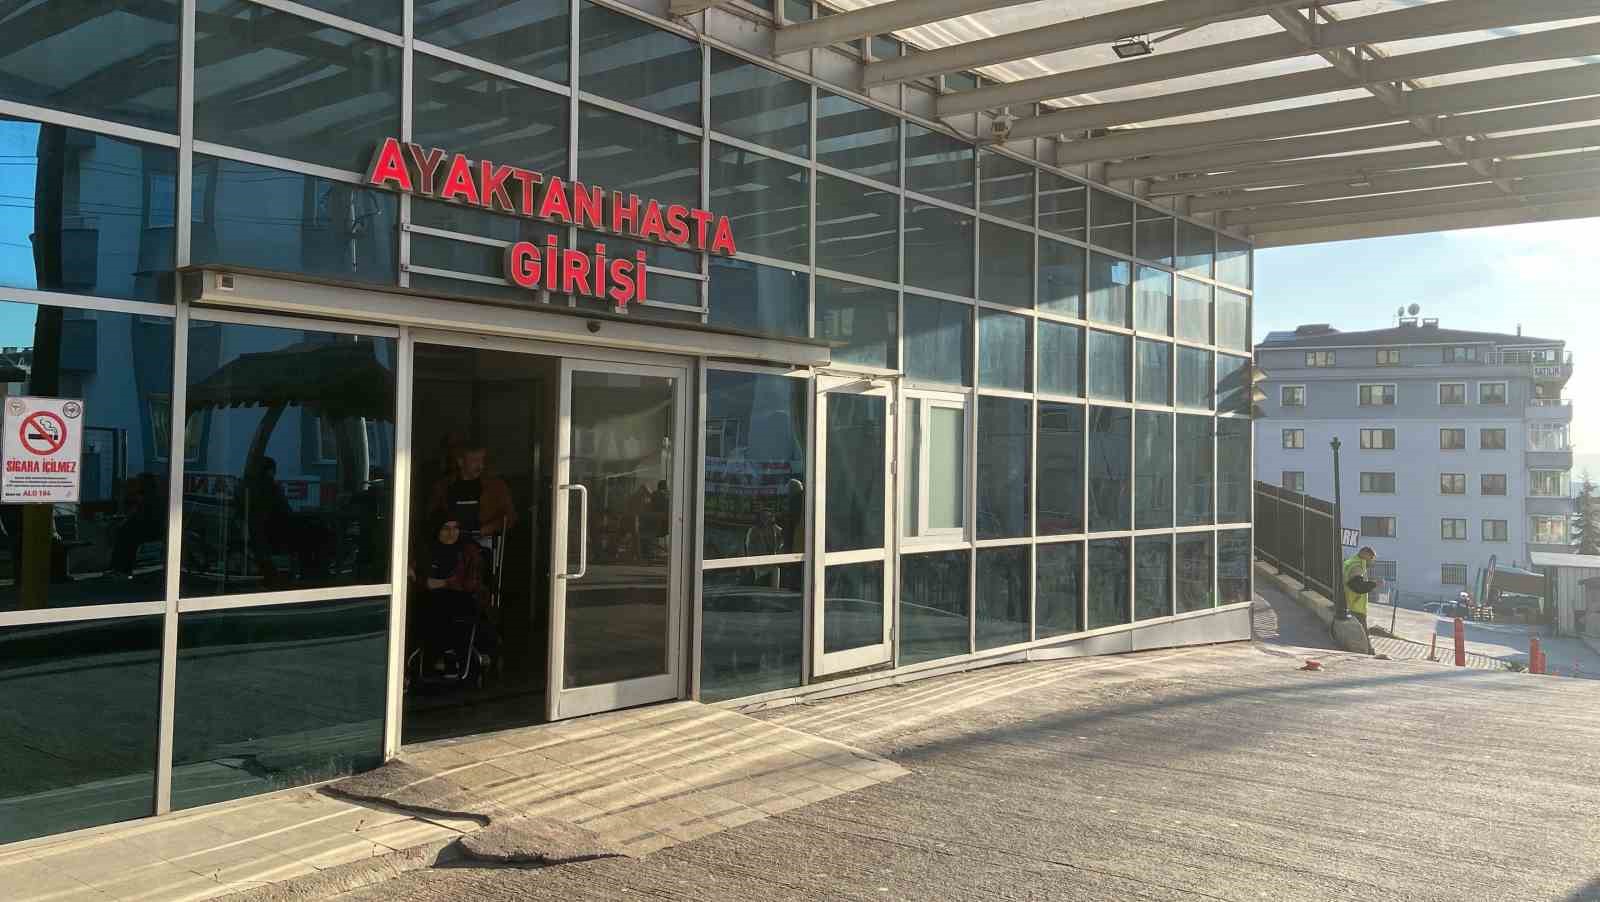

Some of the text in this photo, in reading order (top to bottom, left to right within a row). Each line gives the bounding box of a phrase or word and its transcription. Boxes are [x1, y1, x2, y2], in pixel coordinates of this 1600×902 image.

[370, 136, 737, 257] AYAKTAN HASTA
[510, 234, 648, 308] GİRİŞİ
[6, 458, 40, 473] SİGARA
